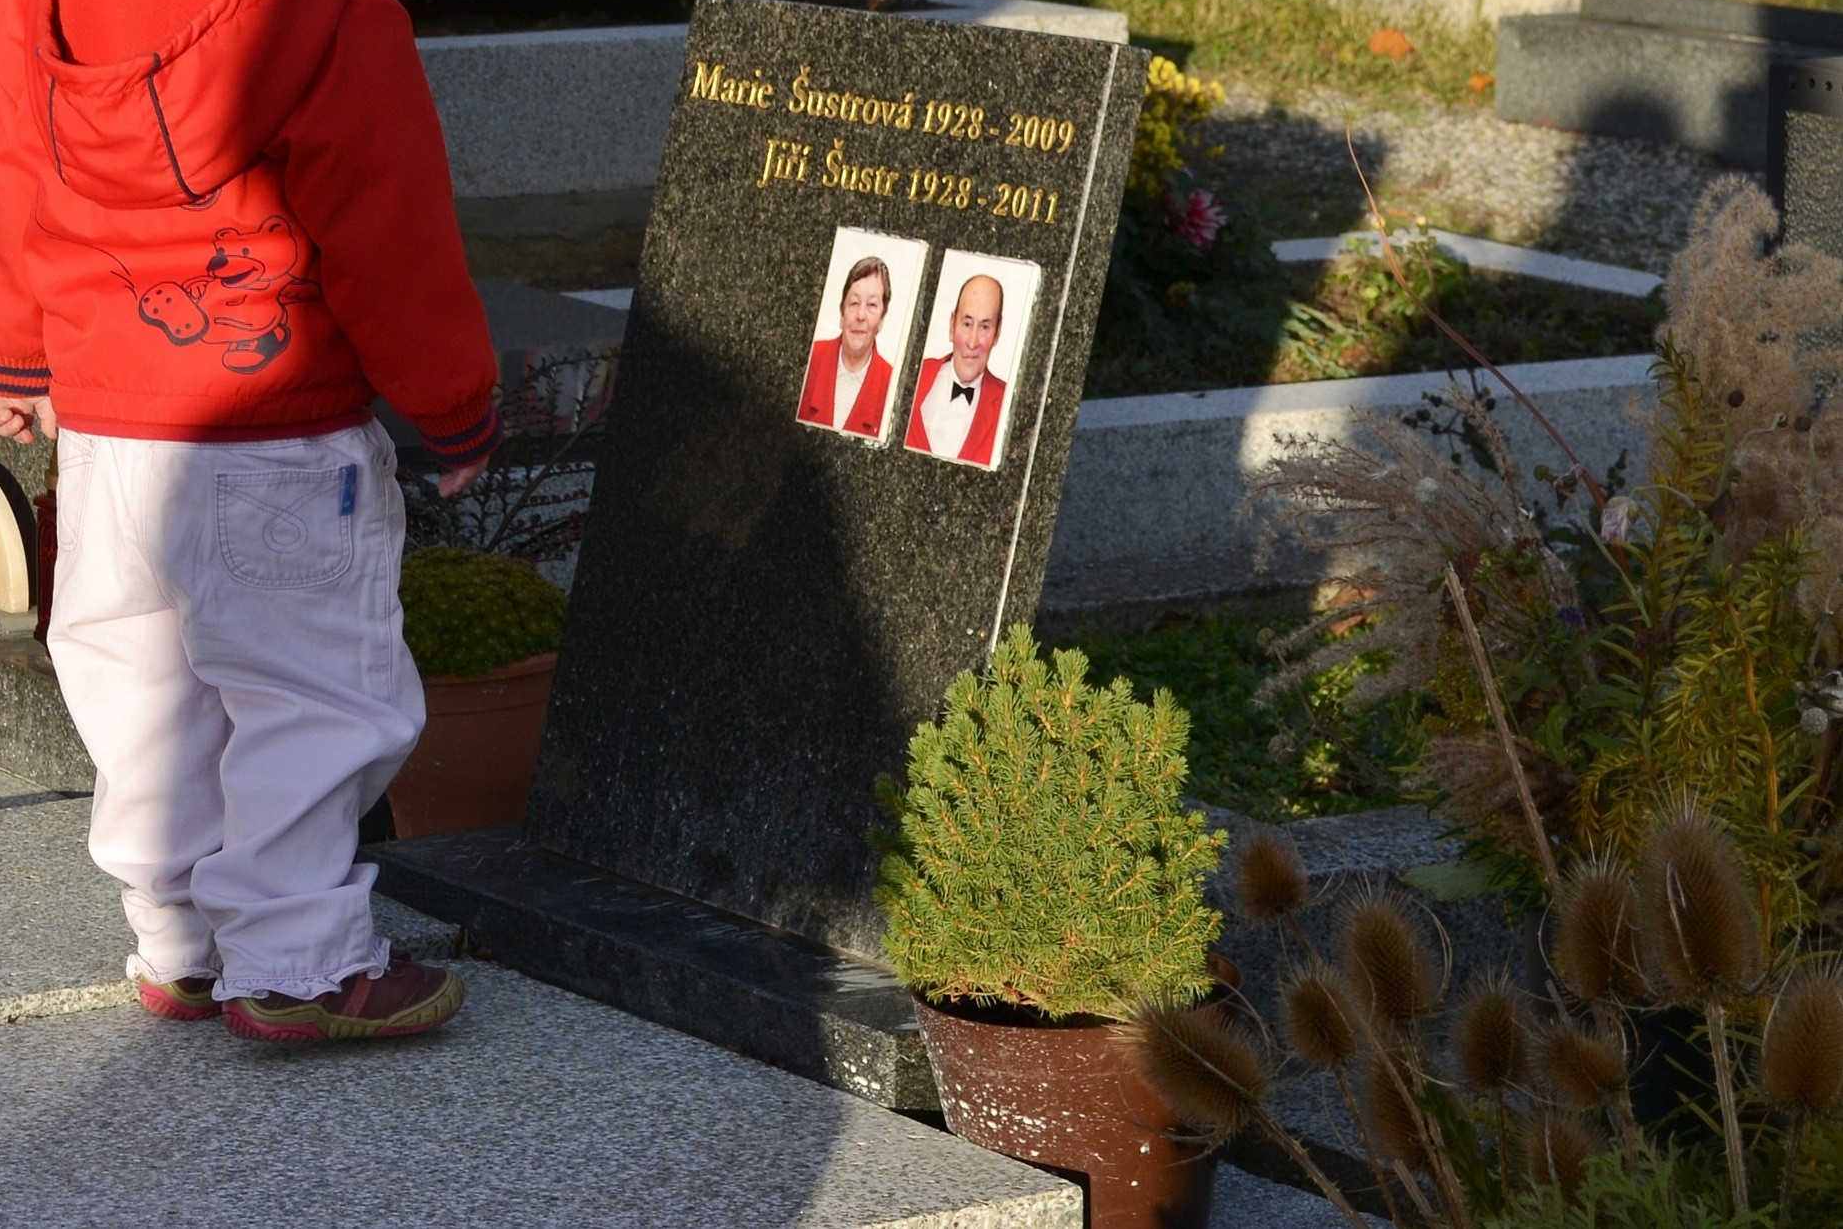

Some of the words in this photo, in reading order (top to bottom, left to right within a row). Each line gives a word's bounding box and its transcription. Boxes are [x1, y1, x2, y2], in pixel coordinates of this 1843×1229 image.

[690, 62, 773, 109] Marie
[788, 66, 913, 130] Šustrová
[922, 100, 984, 139] 1928
[1006, 113, 1074, 153] 2009
[757, 139, 812, 188] Jiří
[823, 140, 899, 196] Šustr
[908, 168, 971, 210] 1928
[993, 182, 1060, 223] 2011
